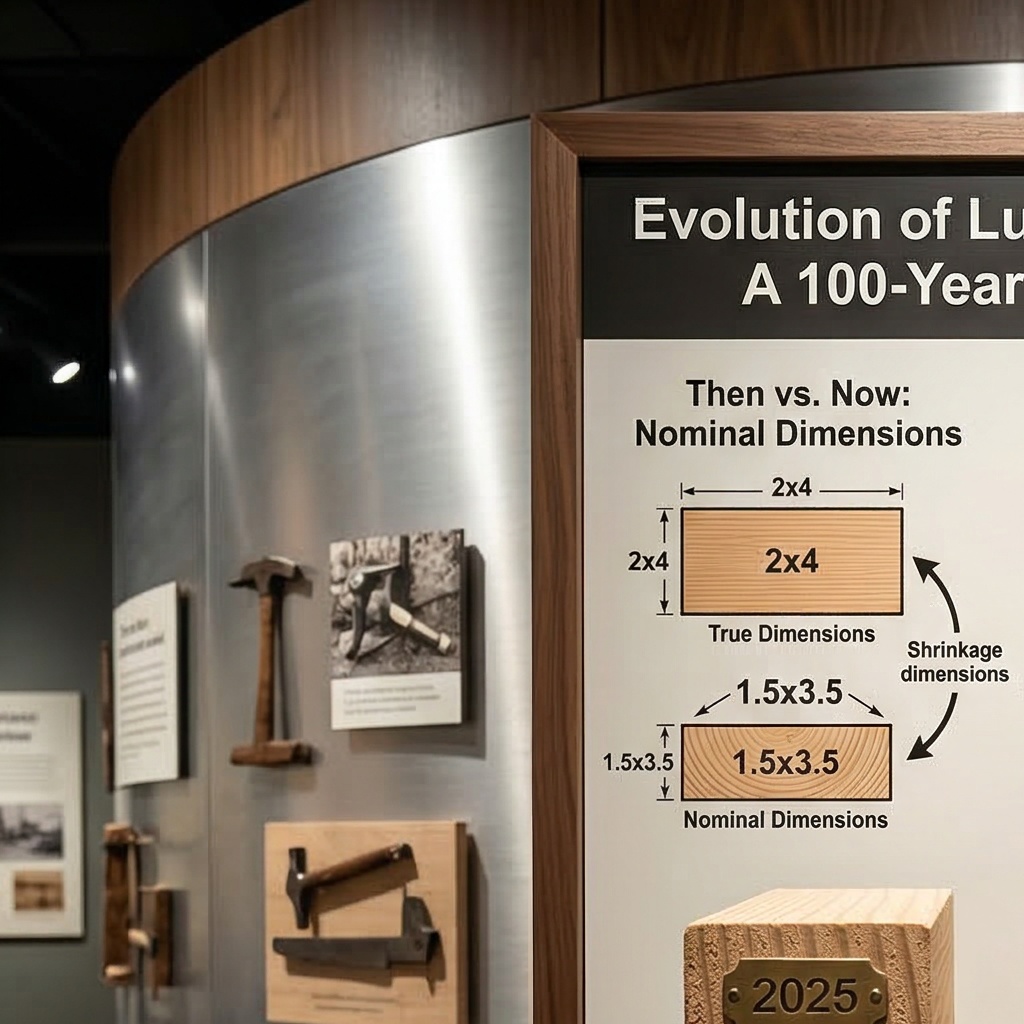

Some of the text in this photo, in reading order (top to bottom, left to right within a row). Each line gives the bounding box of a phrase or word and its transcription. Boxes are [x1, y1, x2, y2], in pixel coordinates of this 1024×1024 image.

[635, 197, 880, 240] Evolution
[901, 197, 953, 240] of
[742, 263, 781, 304] A
[800, 263, 1024, 305] 100-Year
[686, 380, 909, 406] Then vs. Now:
[636, 419, 961, 446] Nominal Dimensions
[772, 477, 812, 496] 2x4
[629, 551, 669, 570] 2x4
[765, 548, 818, 573] 2x4
[708, 625, 875, 642] True Dimensions
[908, 641, 1002, 661] Shrinkage
[901, 665, 1009, 682] dimensions
[737, 679, 842, 704] 1.5x3.5
[604, 753, 673, 771] 1.5x3.5
[733, 749, 838, 775] 1.5x3.5
[685, 810, 888, 828] Nominal Dimensions
[752, 976, 859, 1013] 2025
